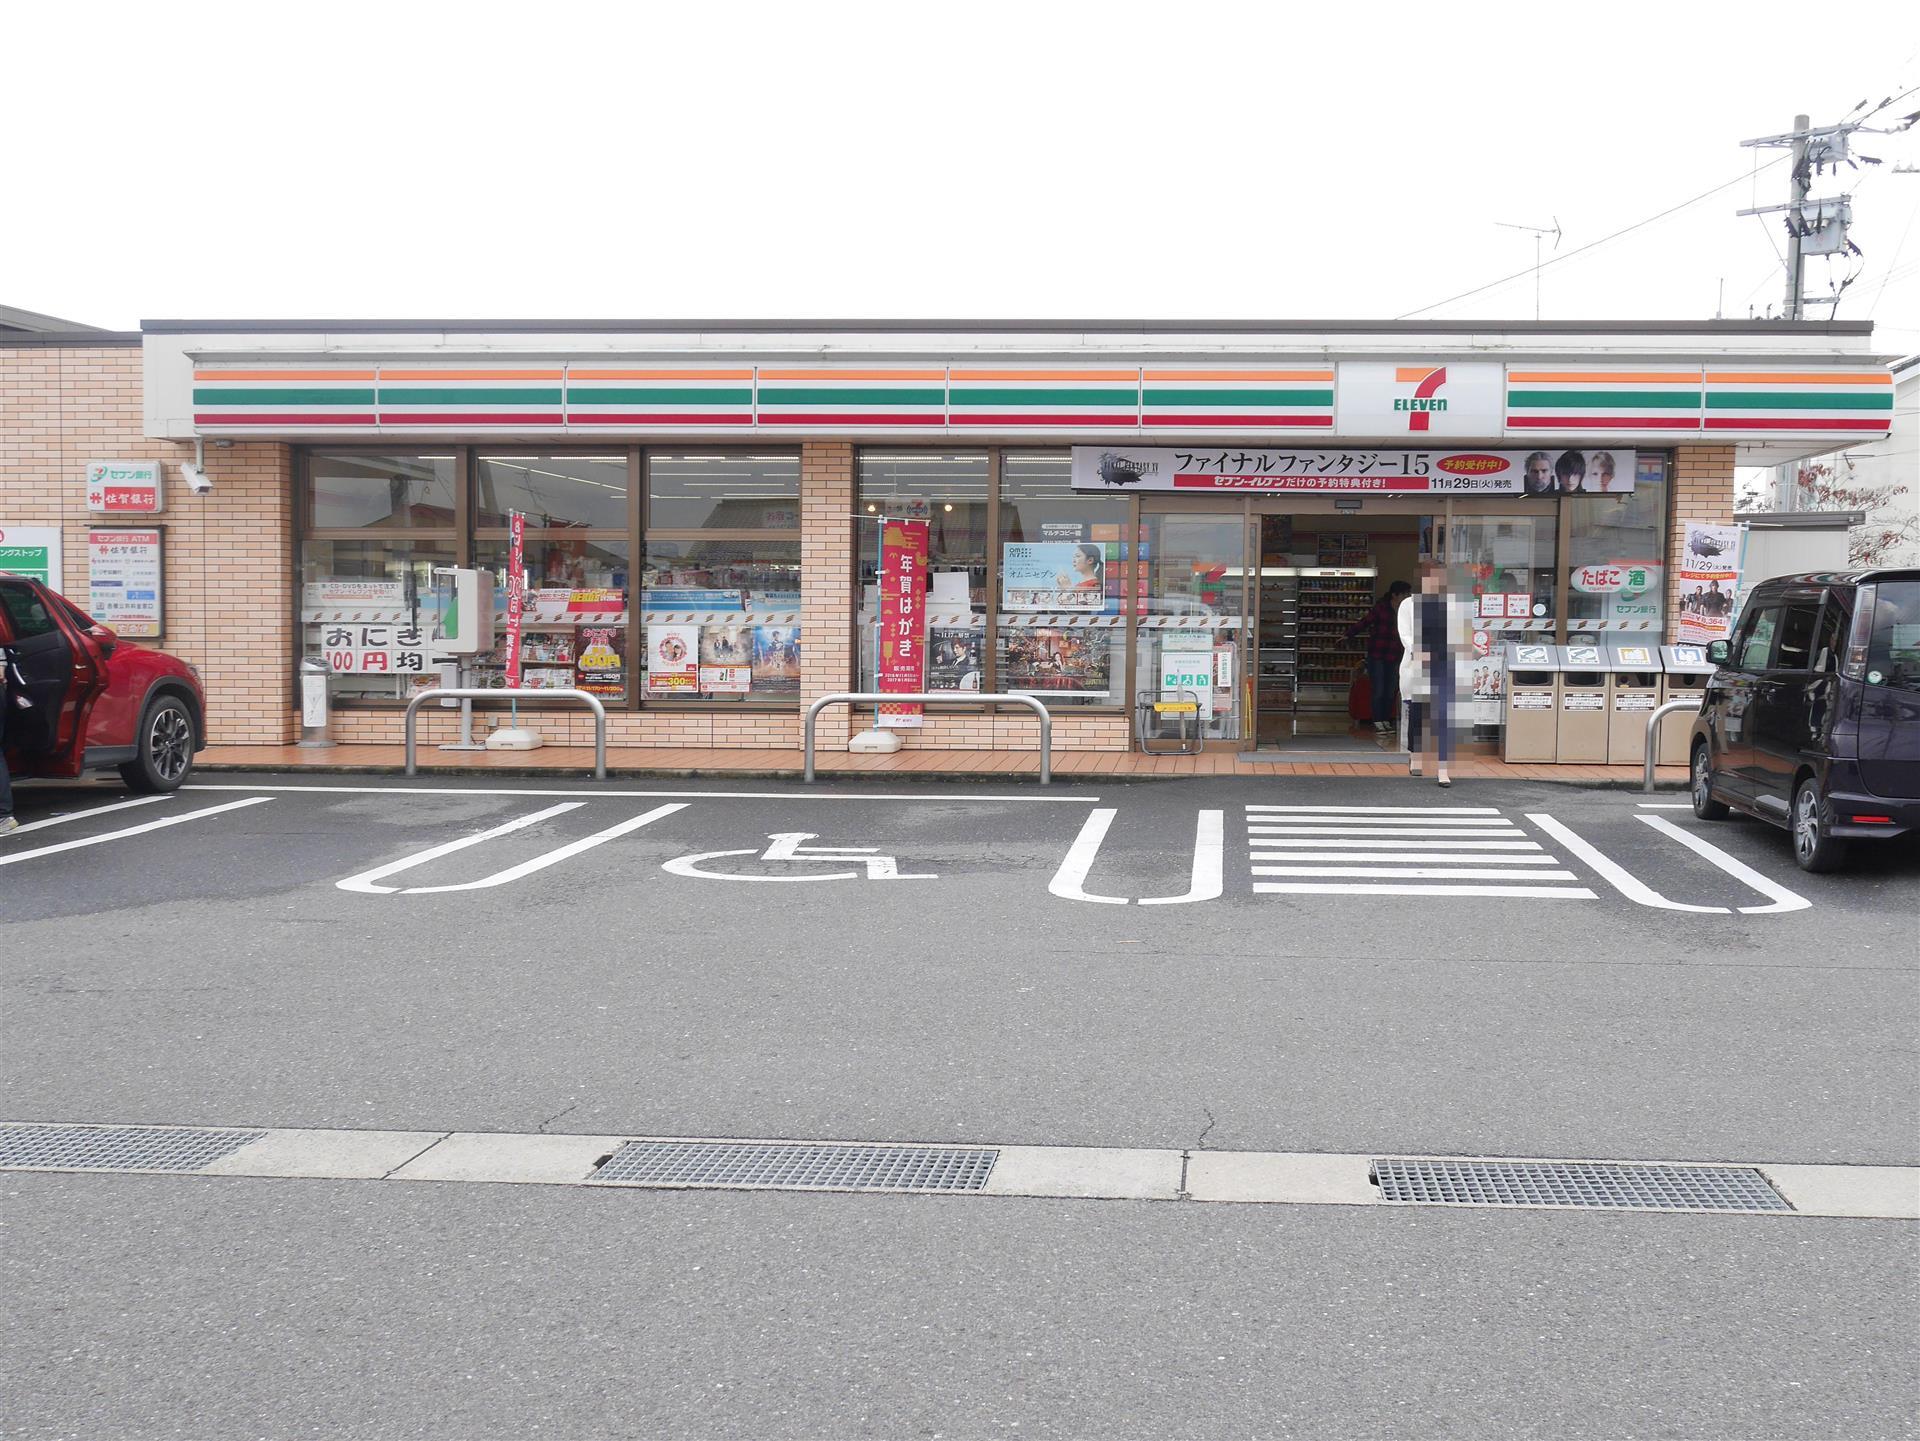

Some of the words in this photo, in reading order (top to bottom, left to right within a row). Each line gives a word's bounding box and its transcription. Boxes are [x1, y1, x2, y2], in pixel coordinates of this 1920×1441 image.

[1174, 452, 1430, 475] ファイナルファンタジー15
[1443, 459, 1503, 470] 予約受付中!
[110, 470, 152, 479] セブン銀行
[105, 493, 154, 504] 佐賀銀行
[131, 535, 150, 543] ATM
[1009, 570, 1057, 578] オムニセブン
[1581, 569, 1621, 586] たばこ
[1628, 569, 1646, 586] 酒
[899, 554, 914, 657] 年賀はがき
[1616, 605, 1657, 614] セブン銀行
[579, 655, 621, 668] 100円
